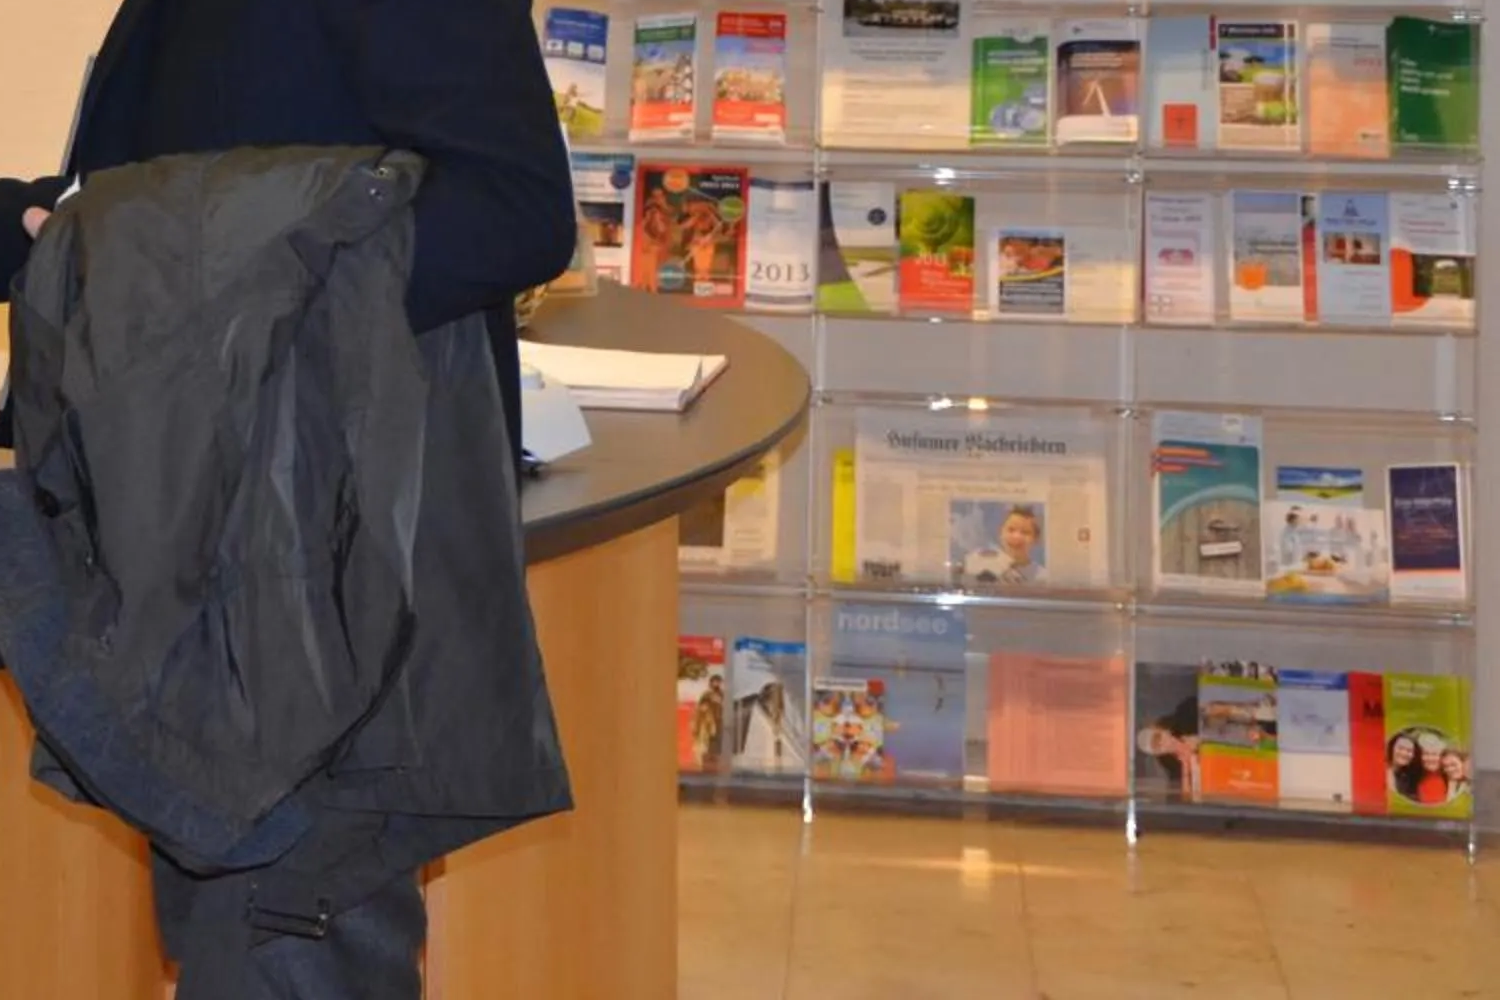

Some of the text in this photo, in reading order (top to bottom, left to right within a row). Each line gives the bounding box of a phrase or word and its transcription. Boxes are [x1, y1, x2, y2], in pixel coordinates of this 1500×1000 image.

[751, 260, 811, 284] 2013
[965, 431, 1068, 455] Nachrichten
[837, 608, 950, 635] nordsee
